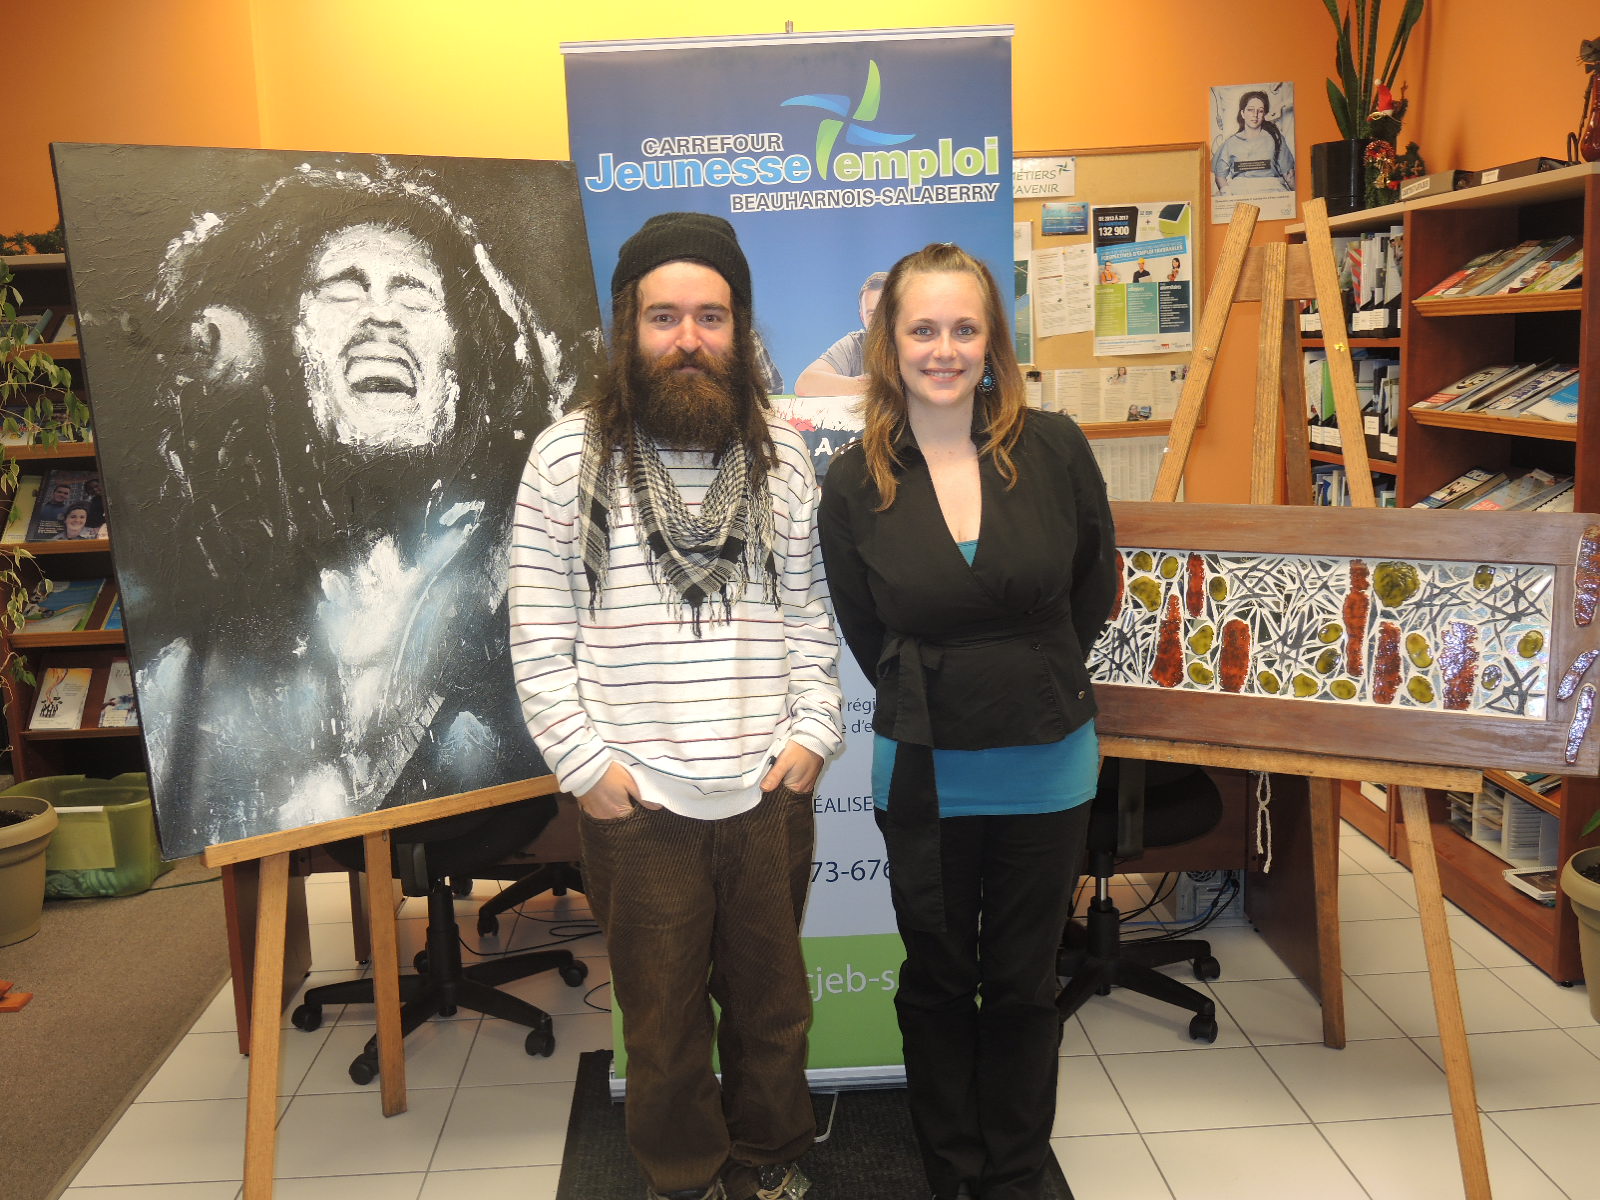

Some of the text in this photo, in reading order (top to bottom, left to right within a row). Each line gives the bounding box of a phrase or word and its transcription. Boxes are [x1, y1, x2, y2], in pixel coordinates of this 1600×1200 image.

[642, 133, 784, 156] CARREFOUR
[585, 136, 999, 192] Jeunesse emploi
[1013, 169, 1056, 181] ÉTIERS
[730, 183, 1000, 213] BEAUHARNOIS-SALABERRY
[1098, 226, 1113, 237] 132
[1113, 226, 1130, 236] 900
[813, 794, 873, 814] ÉALISE
